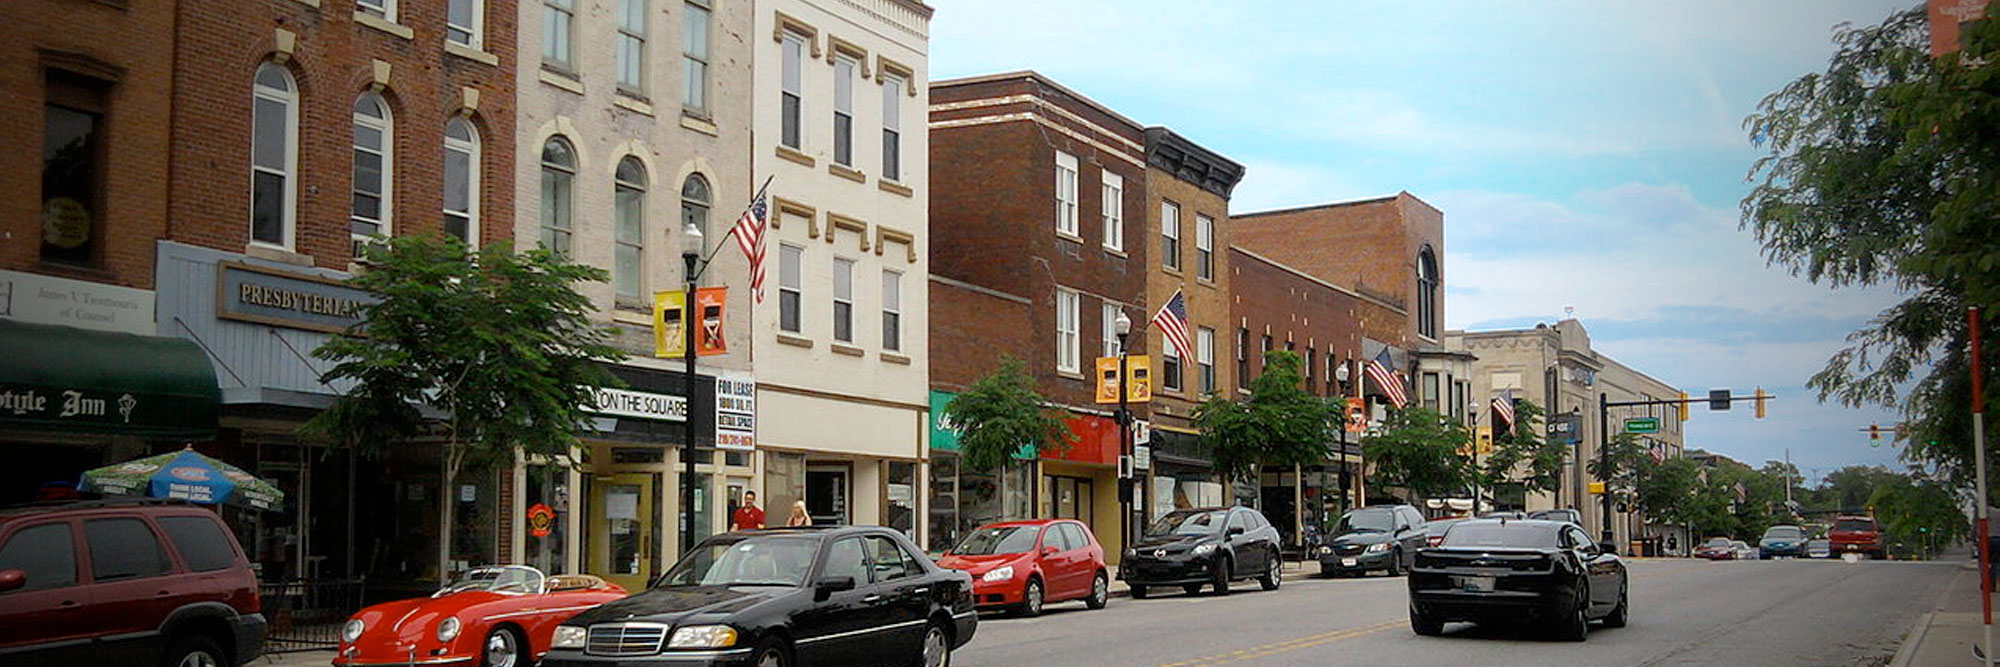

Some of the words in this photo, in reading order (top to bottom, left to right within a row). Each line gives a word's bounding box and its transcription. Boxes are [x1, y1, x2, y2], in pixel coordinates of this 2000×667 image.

[240, 283, 363, 319] PRESBYTERIAN
[719, 379, 732, 394] FOR
[733, 381, 753, 398] LEASE
[60, 390, 105, 417] Inn
[600, 392, 619, 409] ON
[621, 394, 641, 412] THE
[644, 397, 687, 416] SQUARE
